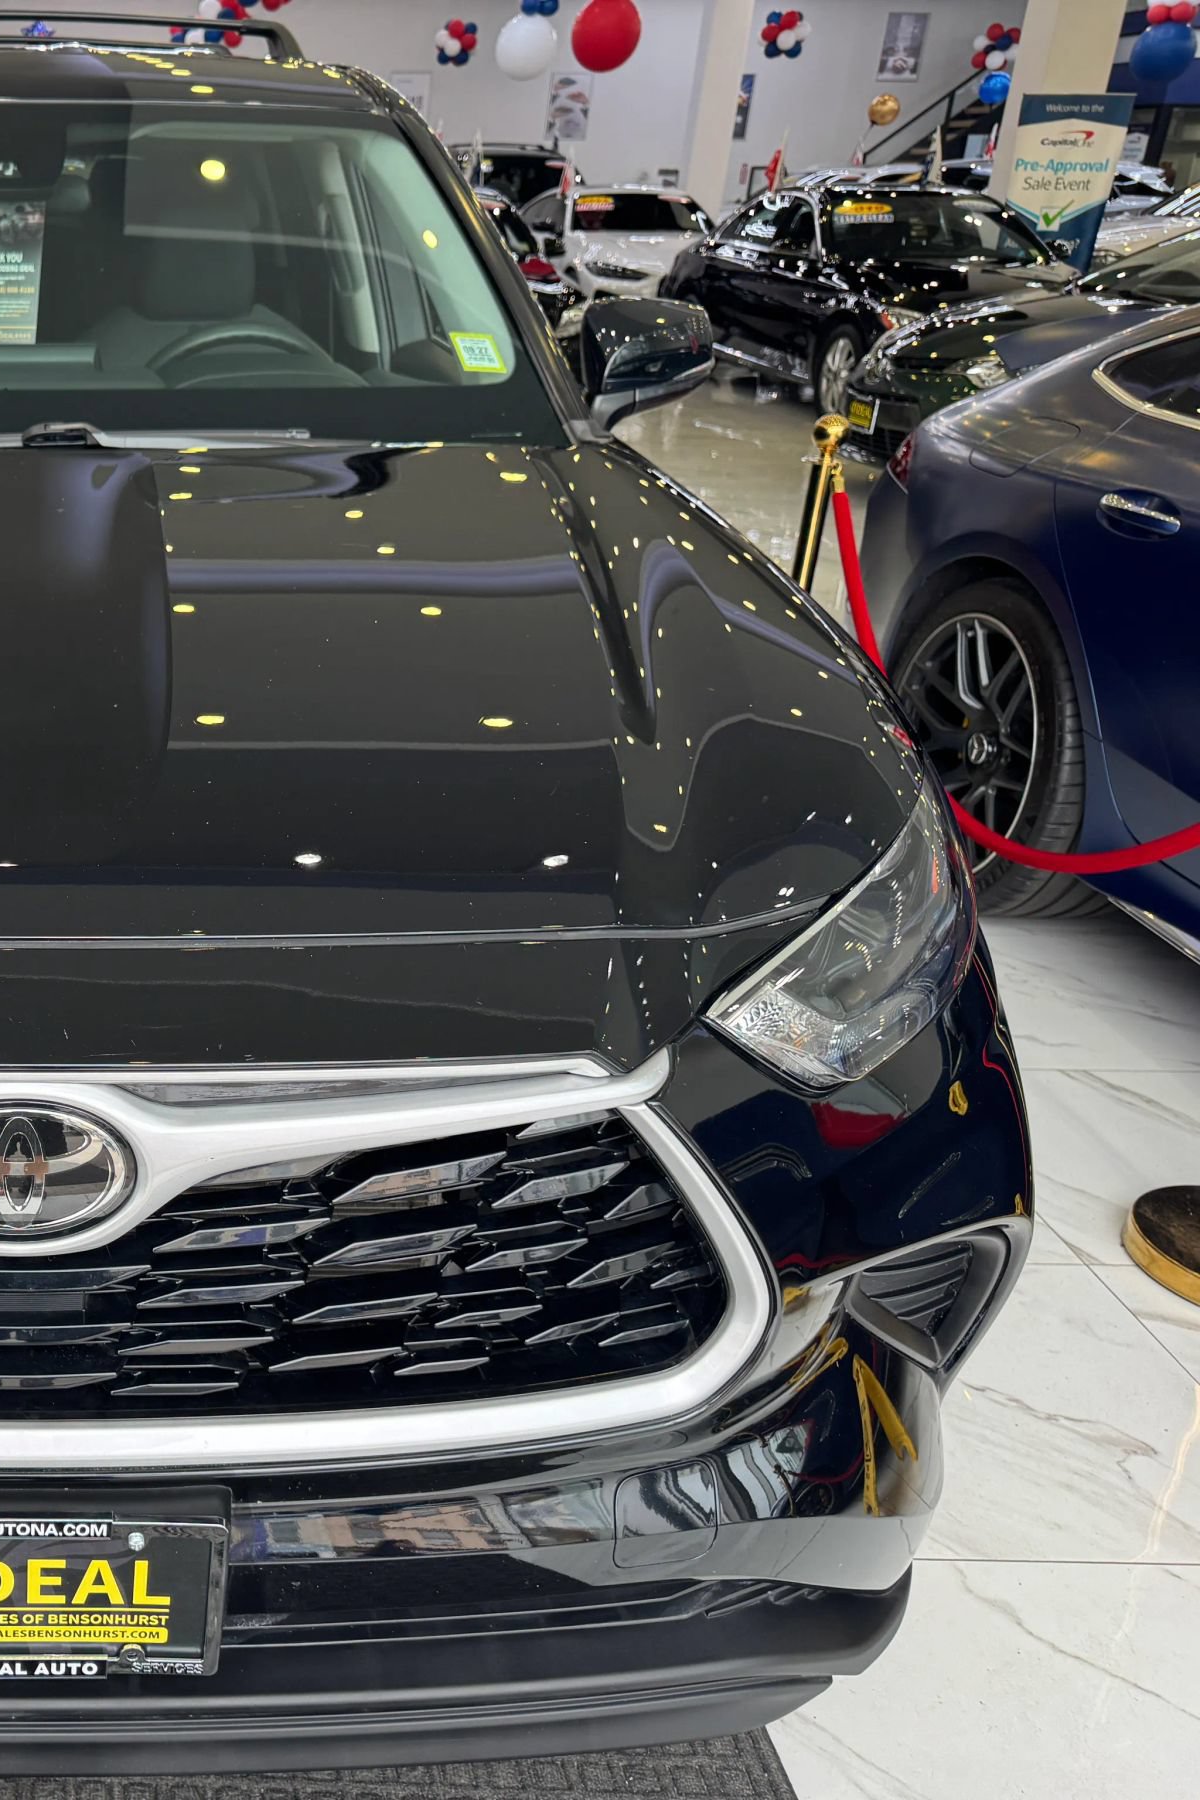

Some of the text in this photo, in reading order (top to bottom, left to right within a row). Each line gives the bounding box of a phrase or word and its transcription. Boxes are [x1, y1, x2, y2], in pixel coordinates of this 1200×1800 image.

[1046, 104, 1104, 113] Welcome to the
[1015, 158, 1110, 177] Pre-Approval
[1022, 176, 1091, 191] Sale Event
[5, 252, 23, 263] YOU
[22, 1613, 44, 1625] OF
[47, 1613, 169, 1626] BENSONHURST
[33, 1662, 99, 1676] AUTO
[131, 1661, 204, 1674] SERVICES
